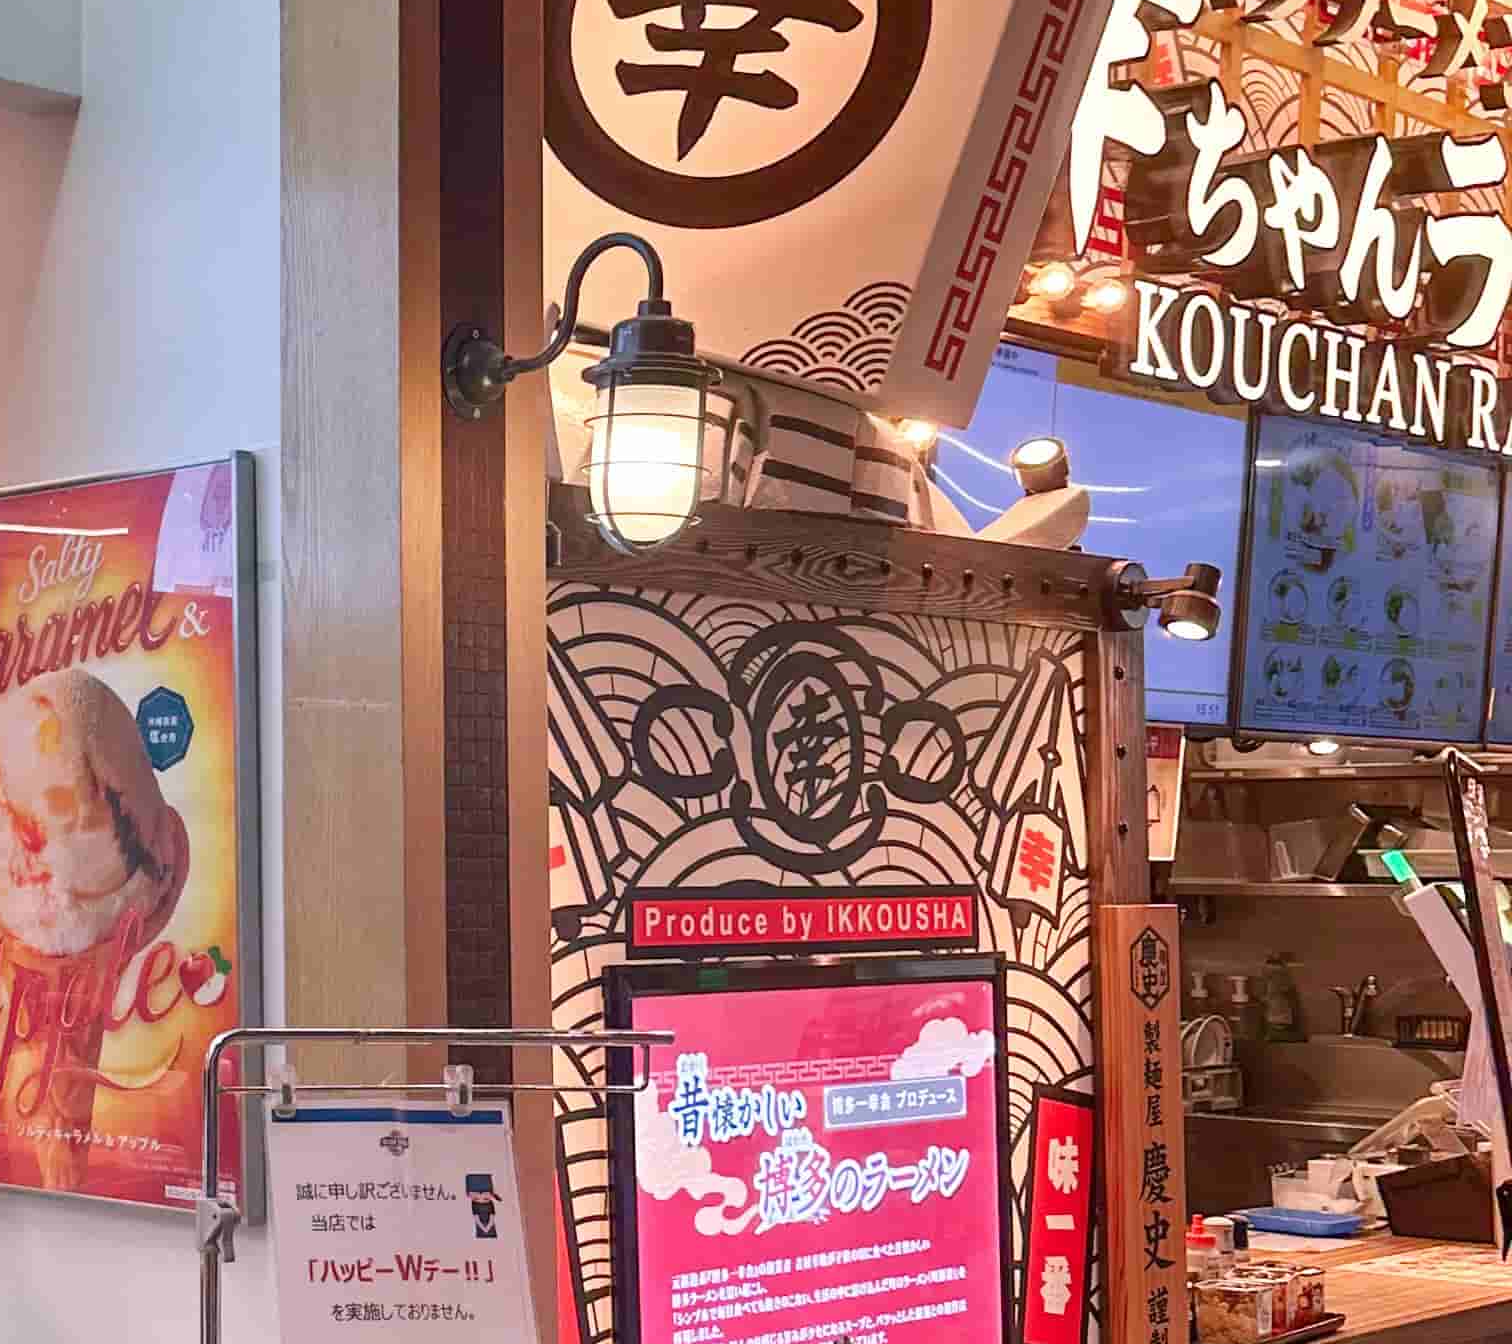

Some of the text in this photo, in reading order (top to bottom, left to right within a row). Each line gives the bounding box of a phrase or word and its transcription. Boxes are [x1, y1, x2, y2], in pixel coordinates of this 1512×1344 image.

[1129, 279, 1512, 457] KOUCHAN R
[17, 536, 105, 604] Salty
[178, 601, 211, 641] &
[643, 894, 969, 941] Produce by IKKOUSHA
[296, 1182, 457, 1202] 誠に申し訳ございません。
[311, 1214, 377, 1233] 当店では
[331, 1303, 476, 1322] を実施しておりません。
